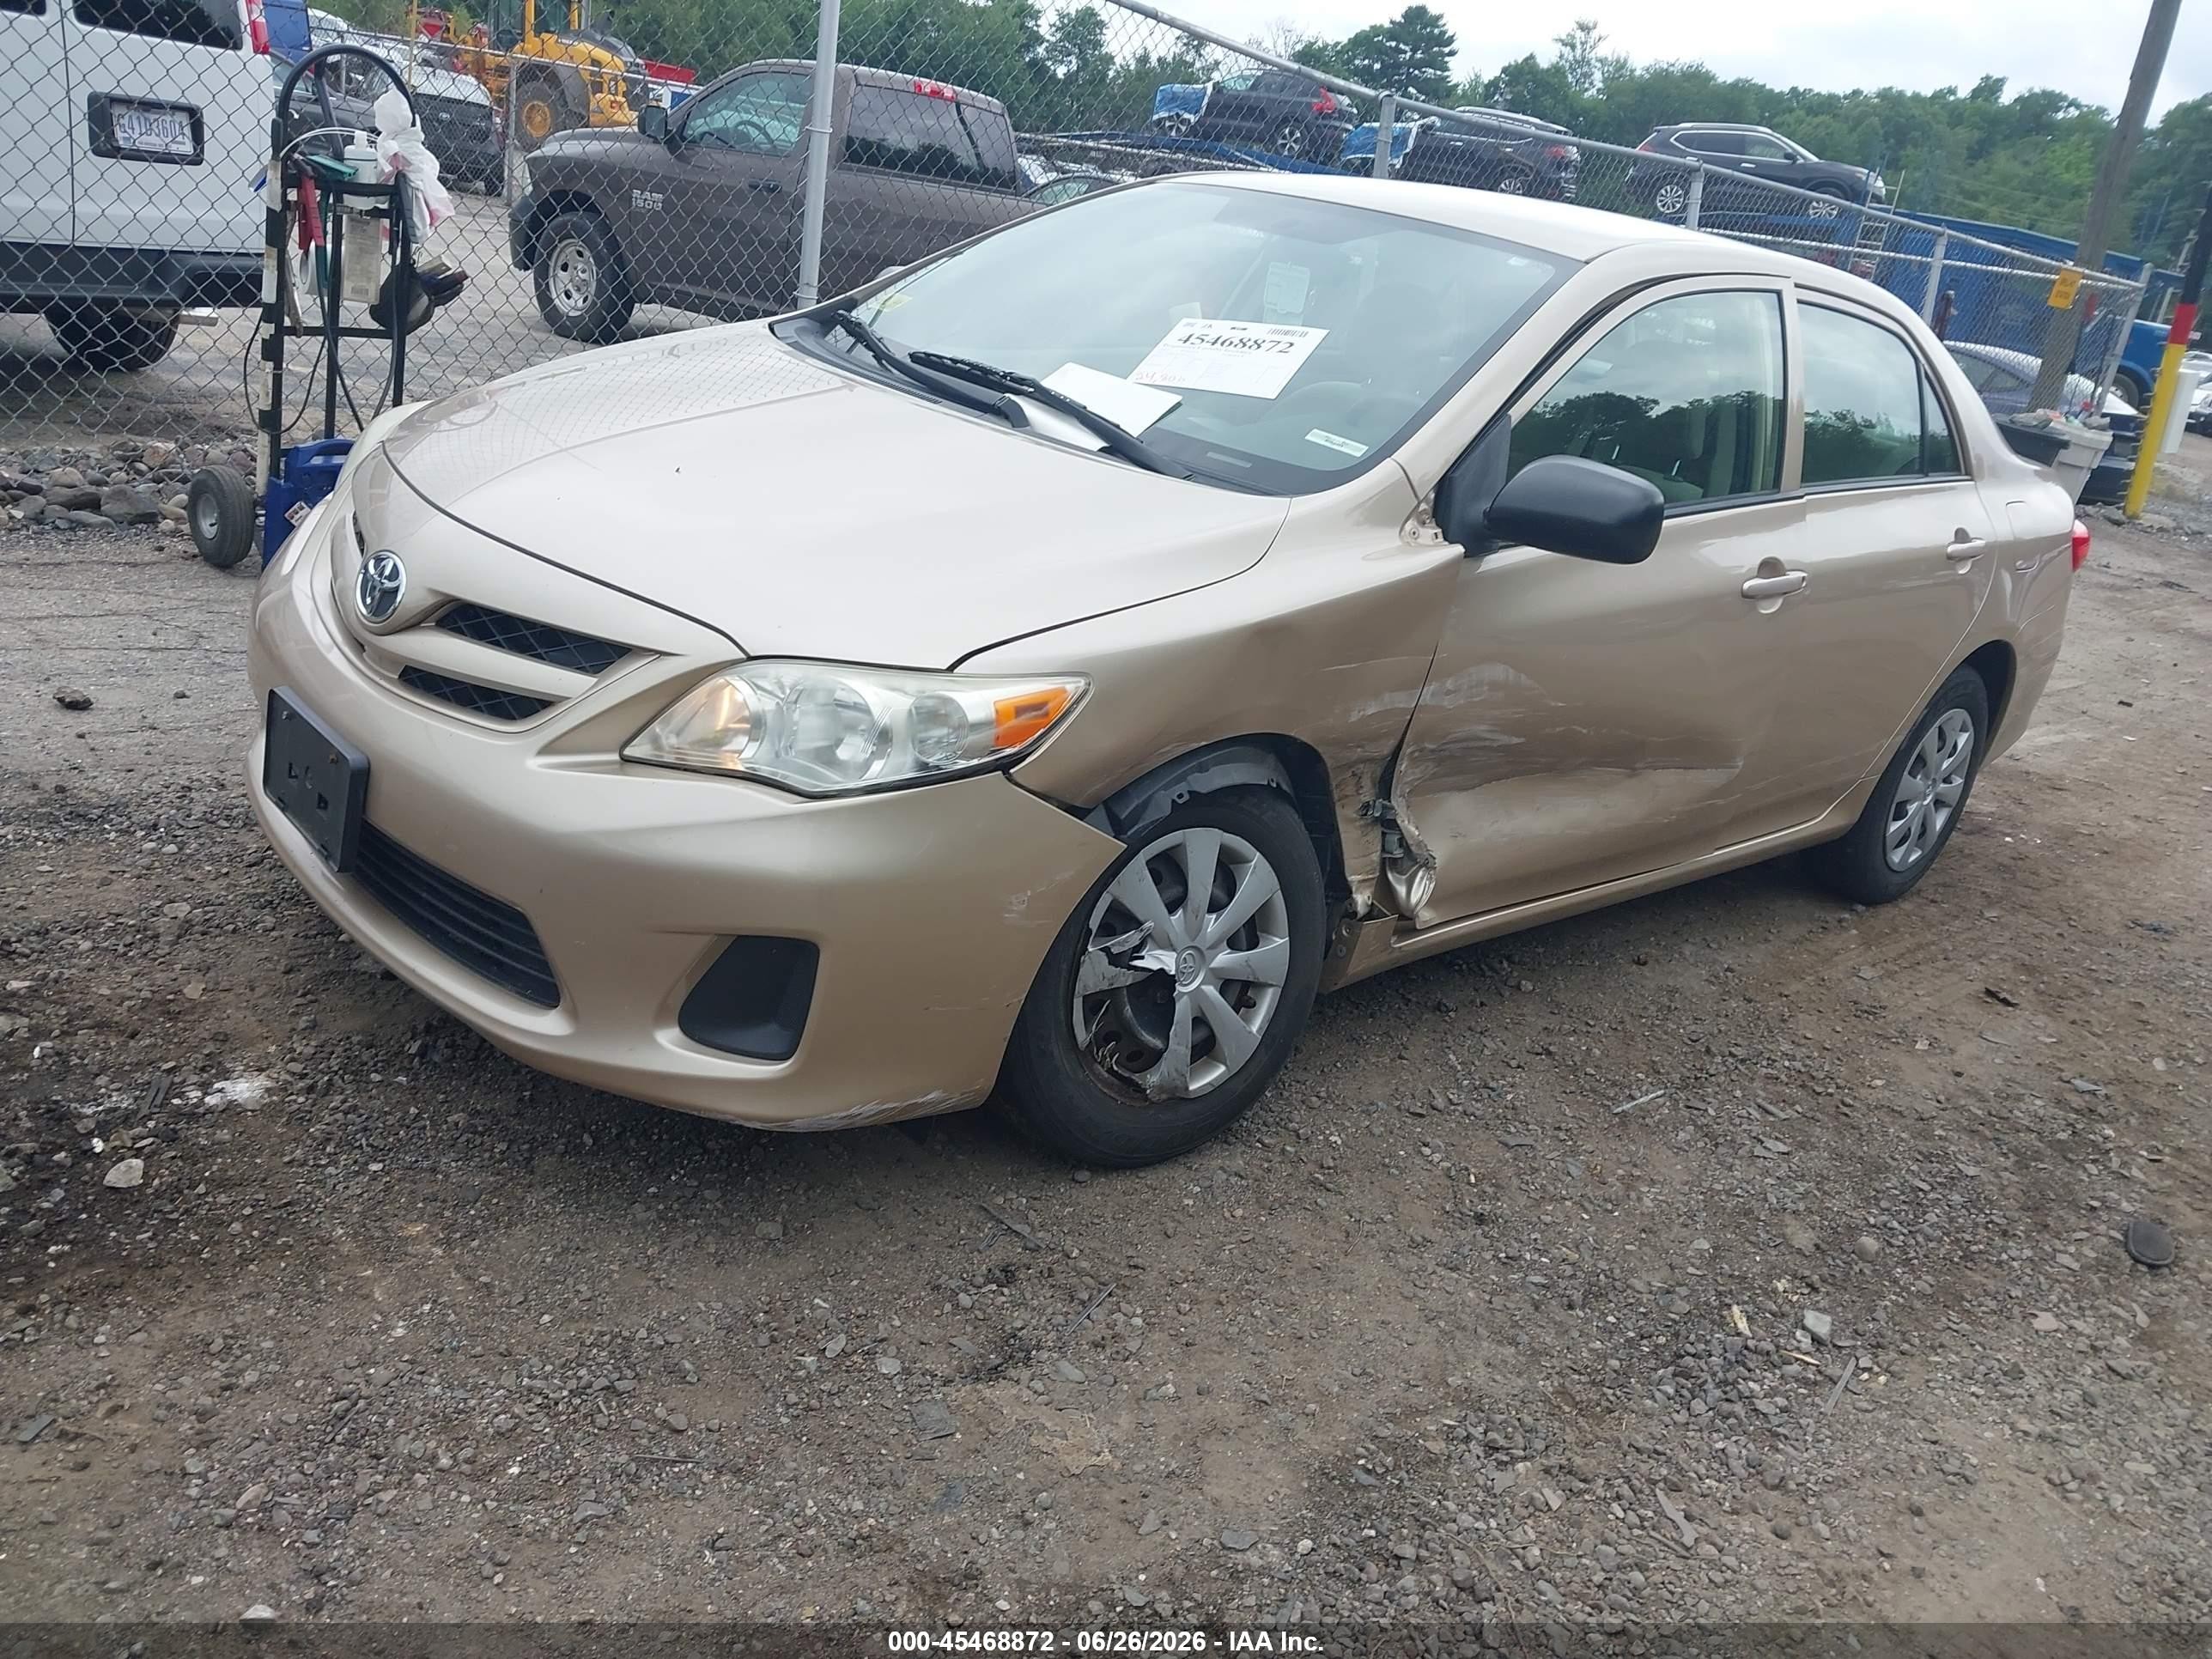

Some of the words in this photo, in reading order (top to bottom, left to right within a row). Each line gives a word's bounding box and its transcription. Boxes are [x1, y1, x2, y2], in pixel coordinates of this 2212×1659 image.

[631, 189, 664, 202] RAM
[631, 198, 663, 210] 1500
[1177, 332, 1295, 354] 45468872
